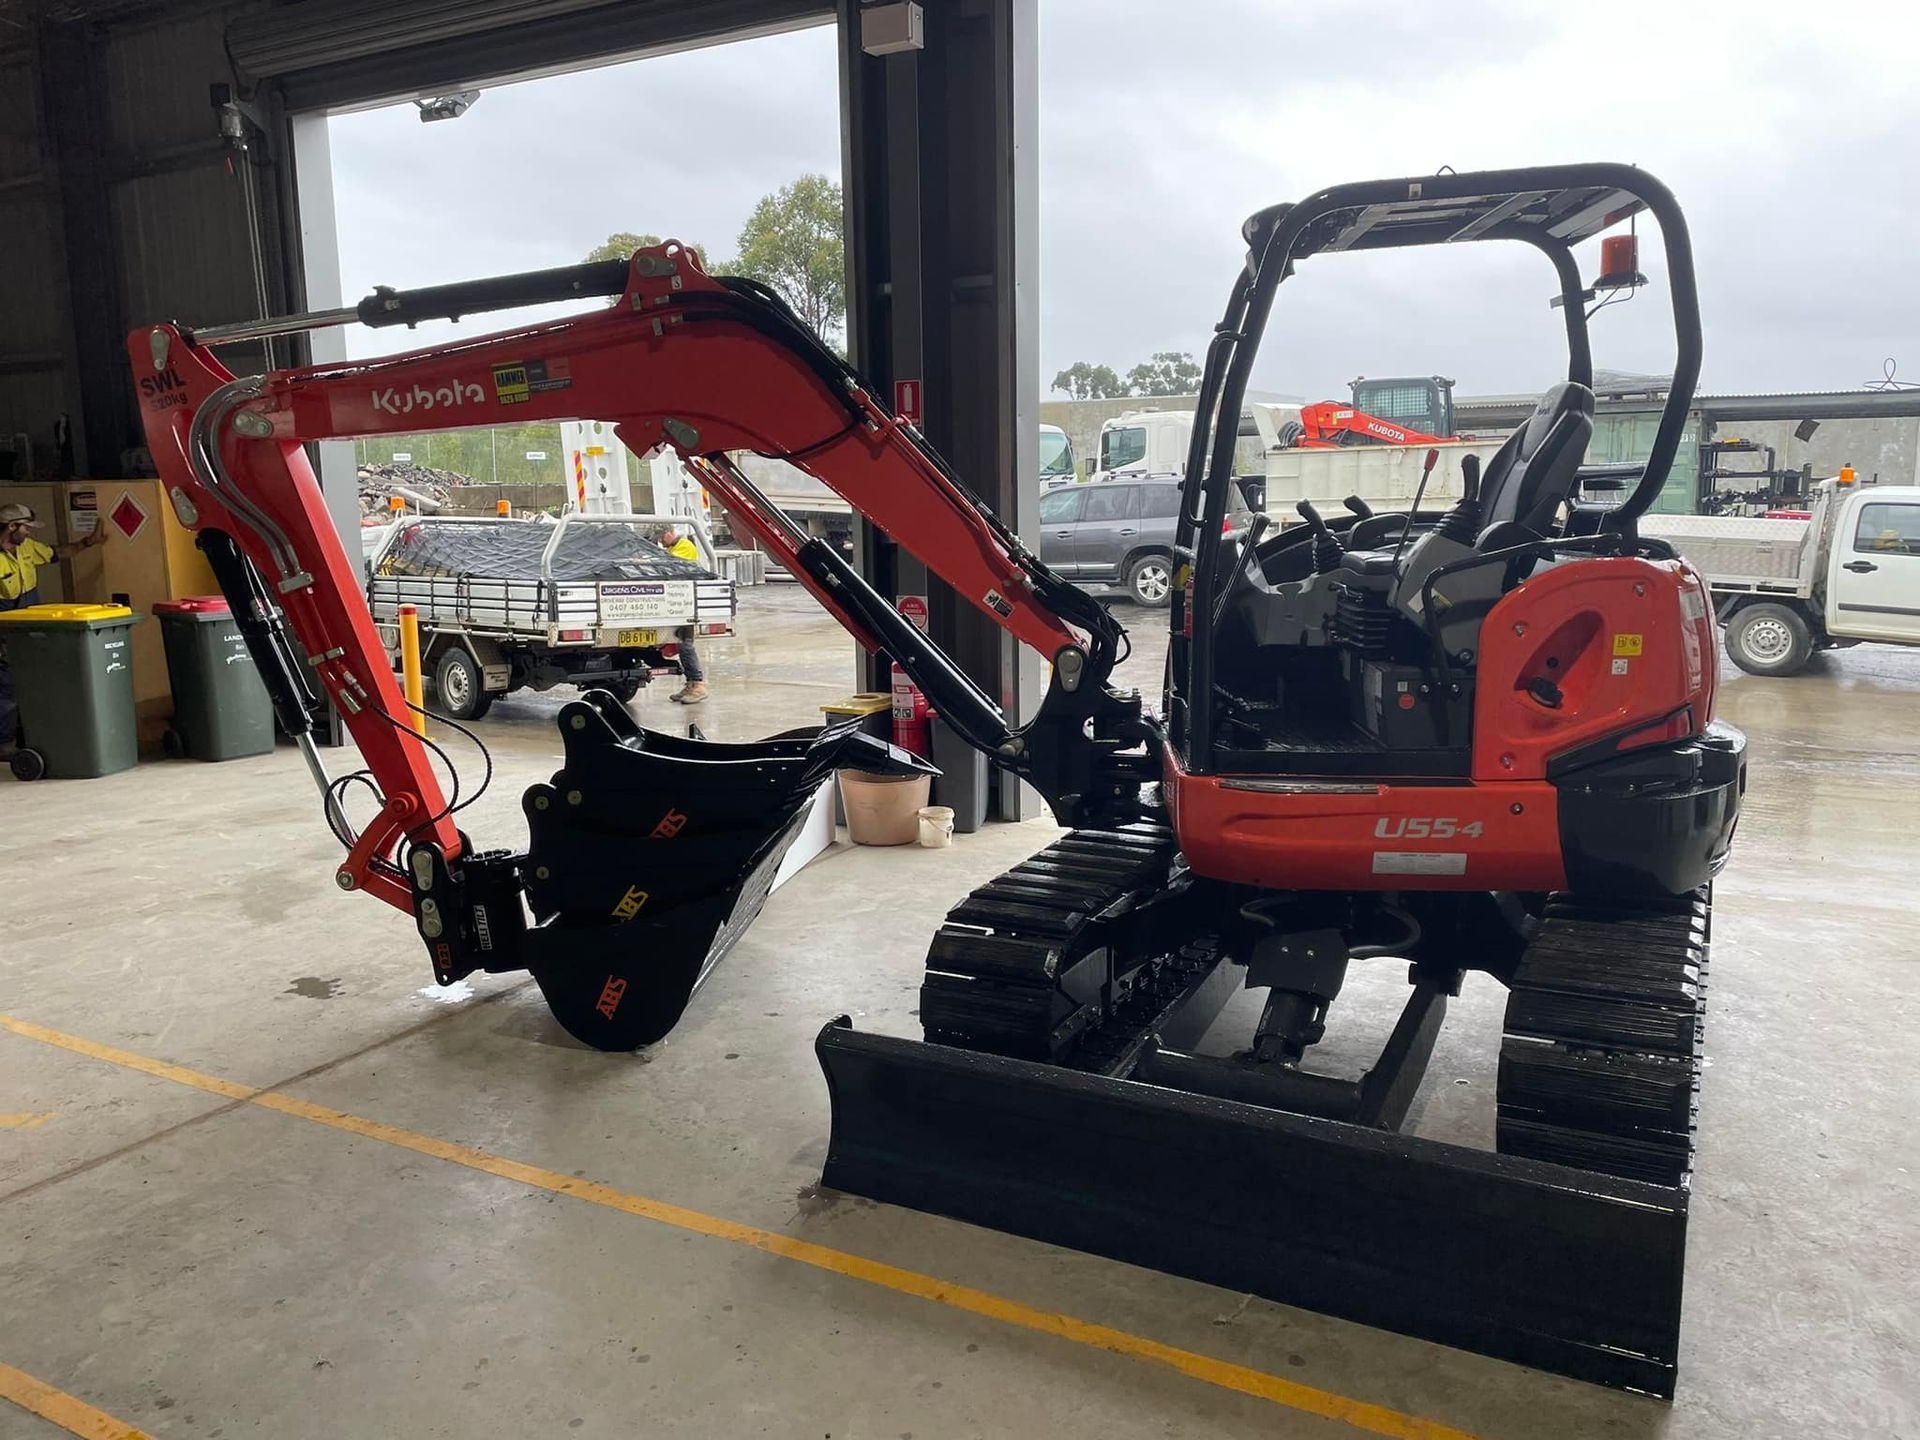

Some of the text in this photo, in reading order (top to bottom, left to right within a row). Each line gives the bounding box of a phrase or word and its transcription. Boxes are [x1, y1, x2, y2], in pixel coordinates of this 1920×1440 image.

[141, 369, 187, 397] SWL
[371, 378, 486, 415] Kubota
[1367, 421, 1405, 442] KUBOTA
[609, 603, 627, 611] 0407
[1374, 817, 1484, 839] U55-4
[596, 974, 628, 1020] ABS
